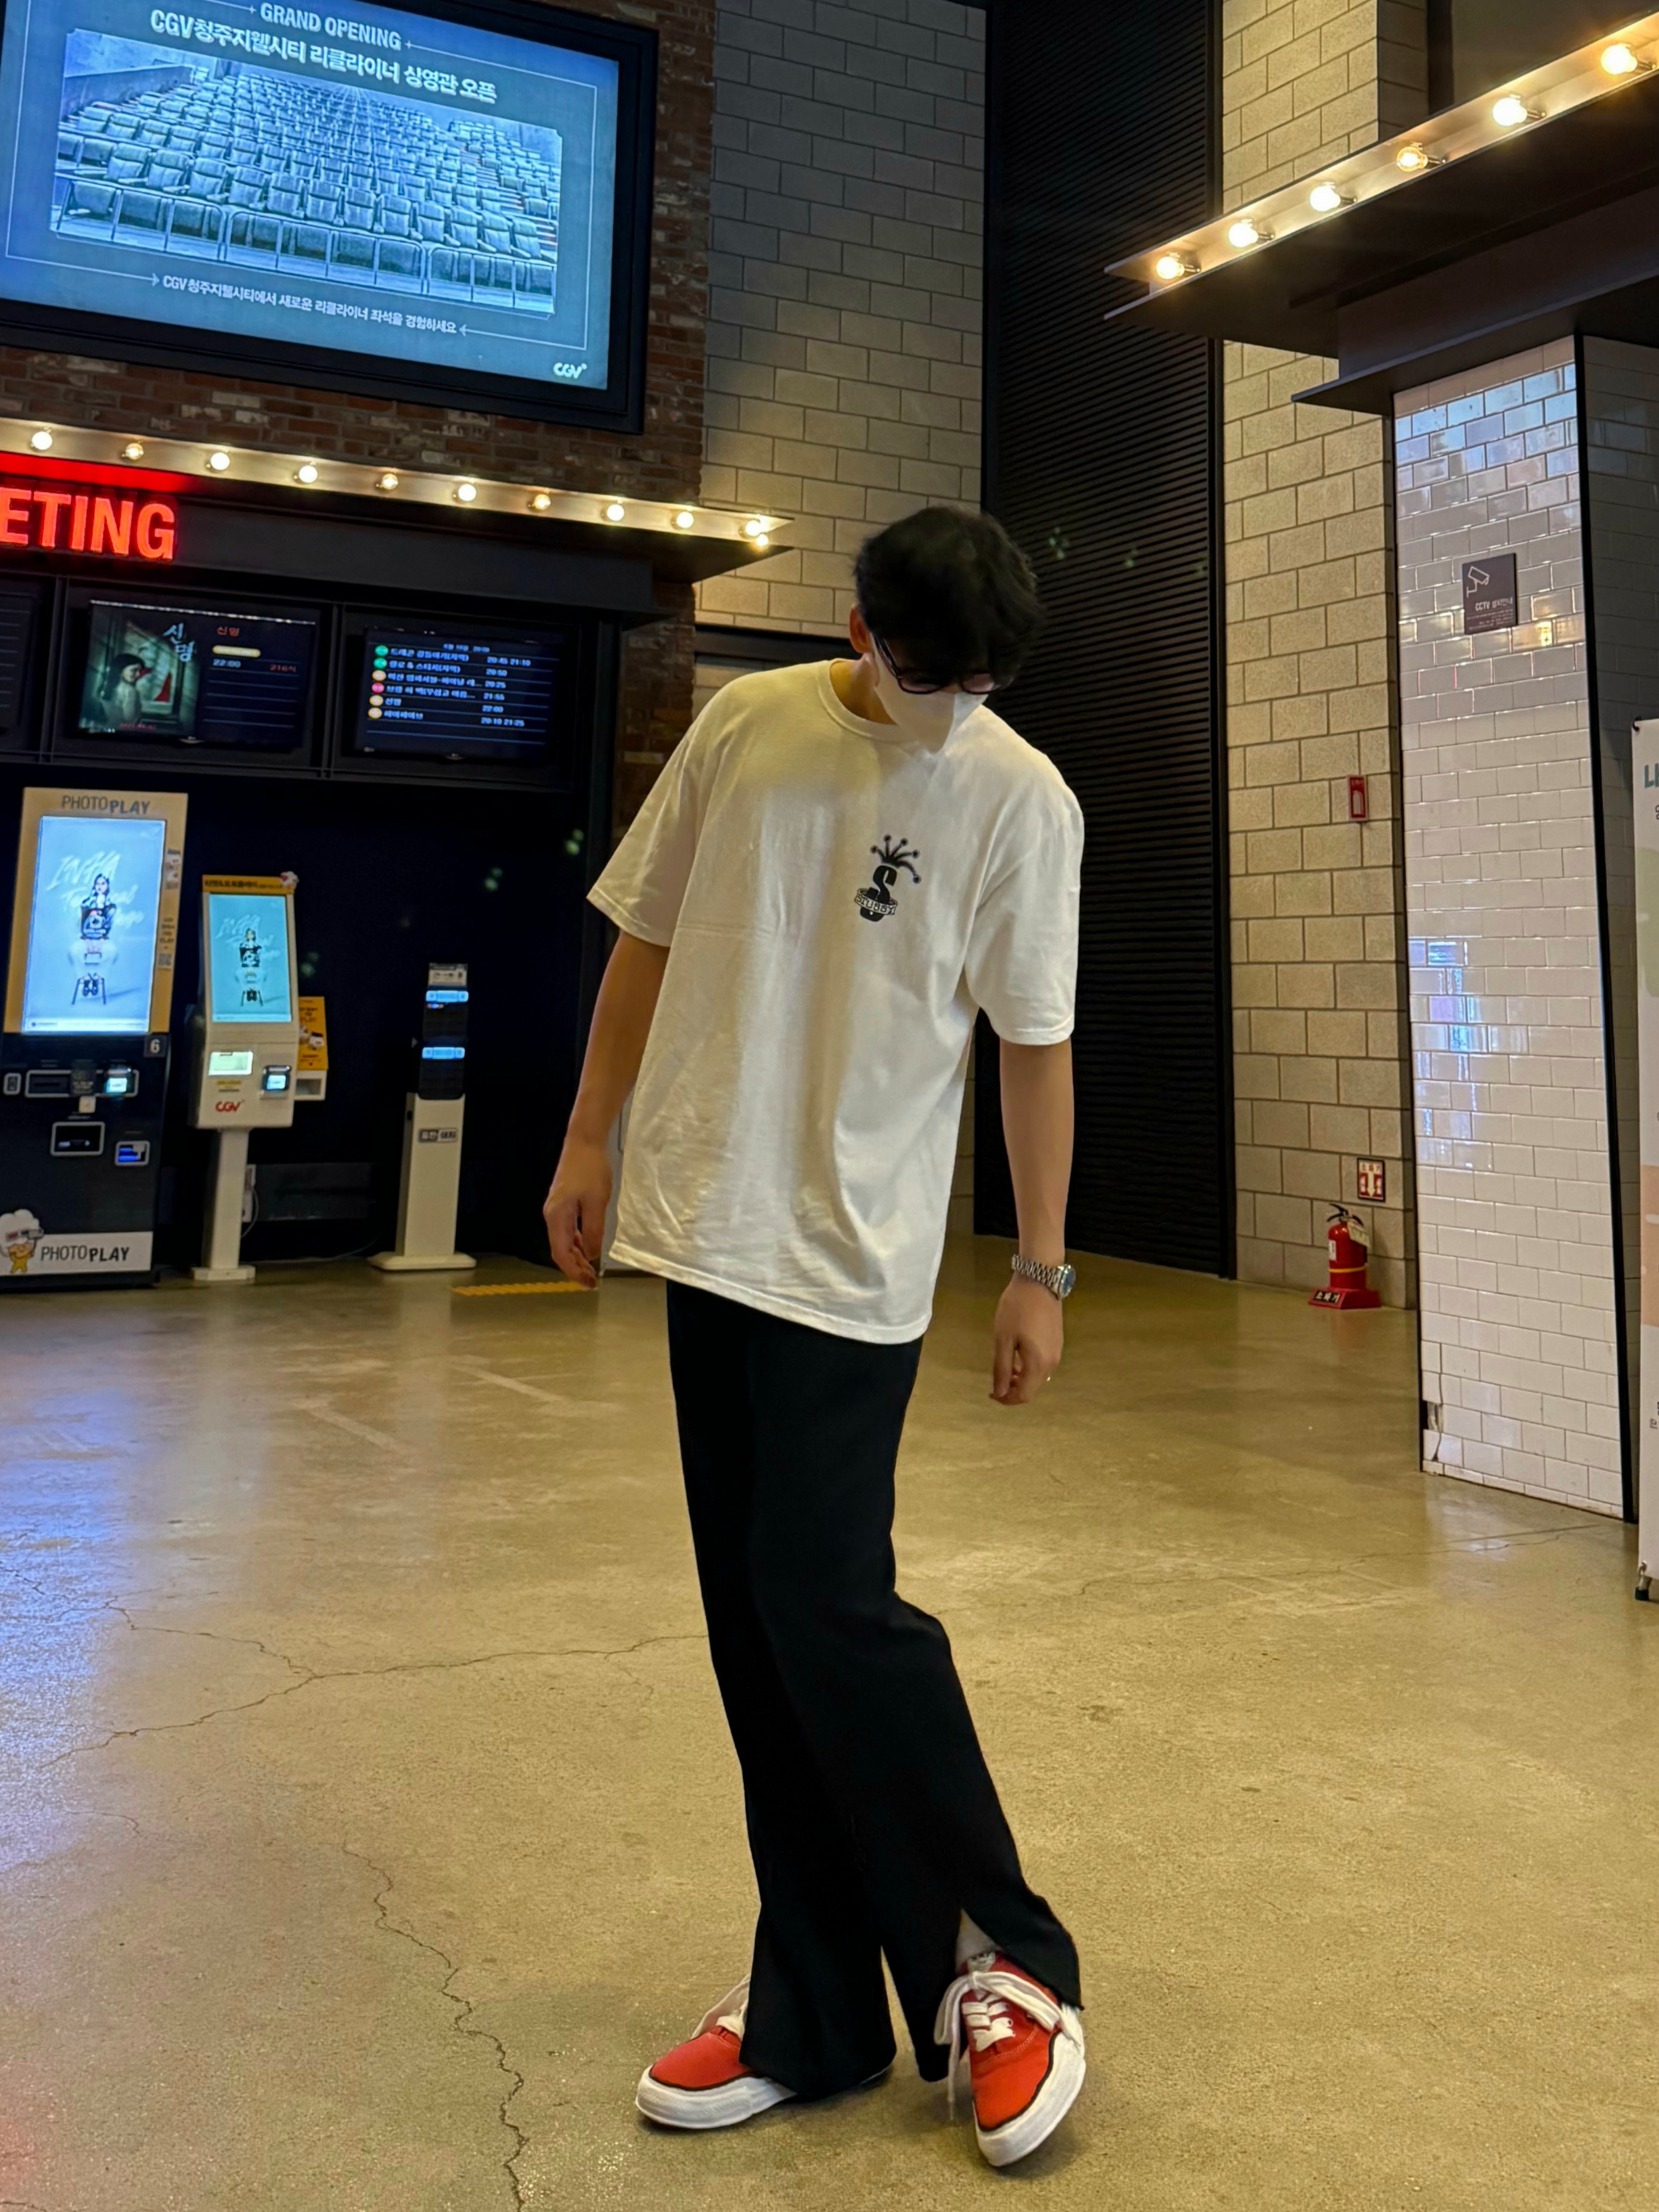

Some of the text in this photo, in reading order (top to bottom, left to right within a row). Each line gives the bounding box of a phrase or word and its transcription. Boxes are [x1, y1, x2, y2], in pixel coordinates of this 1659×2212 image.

[260, 2, 402, 51] GRAND OPENING
[310, 45, 400, 84] 리클라이너
[404, 64, 459, 96] 상영관
[459, 78, 497, 104] 오픈
[278, 294, 313, 312] 새로운
[315, 300, 368, 321] 리클라이너
[370, 309, 403, 326] 좌석을
[405, 314, 457, 334] 경험하세요
[553, 362, 582, 379] CGV
[1475, 601, 1490, 611] CCTV
[212, 659, 241, 668] 22:00
[150, 1039, 160, 1053] 6
[215, 1101, 242, 1112] CGV
